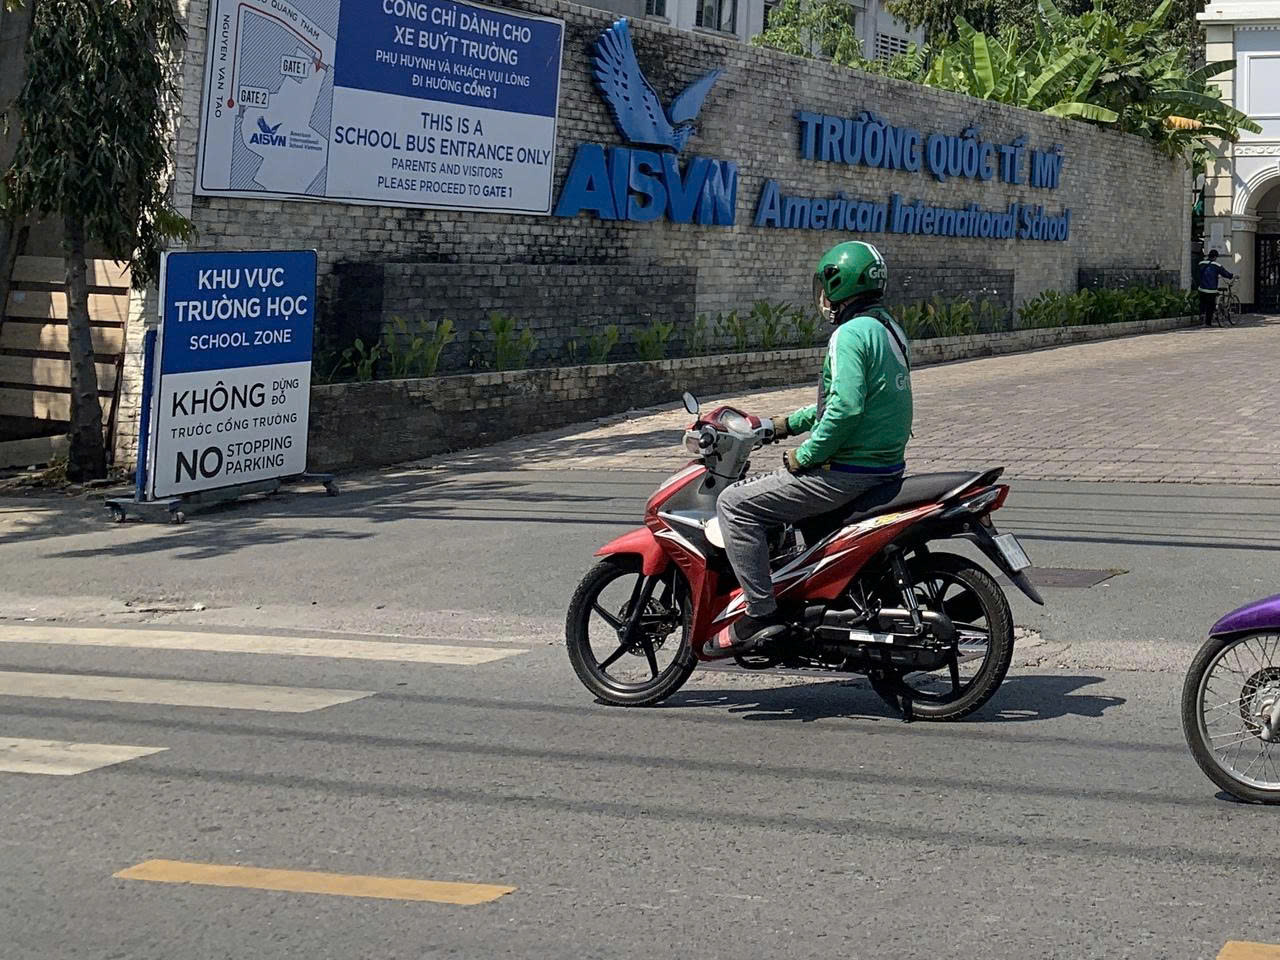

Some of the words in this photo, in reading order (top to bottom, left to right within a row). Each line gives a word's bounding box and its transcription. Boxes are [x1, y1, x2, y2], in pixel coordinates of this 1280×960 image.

[271, 0, 298, 21] QUANG
[300, 19, 320, 41] THAM
[431, 5, 457, 28] CHỈ
[460, 12, 500, 38] DÀNH
[502, 23, 532, 43] CHO
[220, 14, 230, 61] NGUYEN
[393, 25, 415, 46] XE
[418, 31, 459, 54] BUÝT
[461, 41, 518, 66] TRƯỜNG
[217, 66, 226, 90] VAN
[283, 60, 303, 74] GATE
[375, 50, 398, 67] PHỤ
[400, 54, 436, 72] HUYNH
[438, 58, 451, 74] VÀ
[453, 63, 486, 81] KHÁCH
[488, 70, 503, 83] VUI
[505, 71, 531, 87] LÒNG
[412, 74, 424, 87] ĐI
[214, 95, 223, 119] TAO
[240, 90, 261, 104] GATE
[421, 111, 453, 132] THIS
[457, 117, 470, 135] IS
[473, 119, 484, 136] A
[249, 131, 287, 148] AISVN
[334, 125, 401, 150] SCHOOL
[405, 134, 436, 154] BUS
[440, 138, 514, 162] ENTRANCE
[516, 146, 552, 166] ONLY
[794, 110, 922, 174] TRƯỜNG
[925, 122, 995, 183] QUỐC
[999, 134, 1031, 186] TẾ
[1031, 143, 1065, 189] MỸ
[391, 157, 437, 174] PARENTS
[439, 161, 461, 176] AND
[462, 164, 504, 180] VISITORS
[377, 175, 417, 191] PLEASE
[419, 178, 467, 195] PROCEED
[468, 183, 481, 196] TO
[482, 185, 507, 198] GATE
[553, 143, 738, 226] AISVN
[753, 178, 888, 234] American
[890, 191, 1019, 240] International
[1019, 203, 1073, 242] School
[197, 268, 240, 290] KHU
[243, 266, 285, 293] VỰC
[174, 294, 262, 322] TRƯỜNG
[266, 294, 308, 321] HỌC
[189, 332, 250, 351] SCHOOL
[253, 328, 292, 346] ZONE
[272, 378, 300, 391] DỪNG
[171, 380, 266, 418] KHÔNG
[226, 435, 293, 458] STOPPING
[174, 445, 224, 484] NO
[225, 453, 284, 476] PARKING
